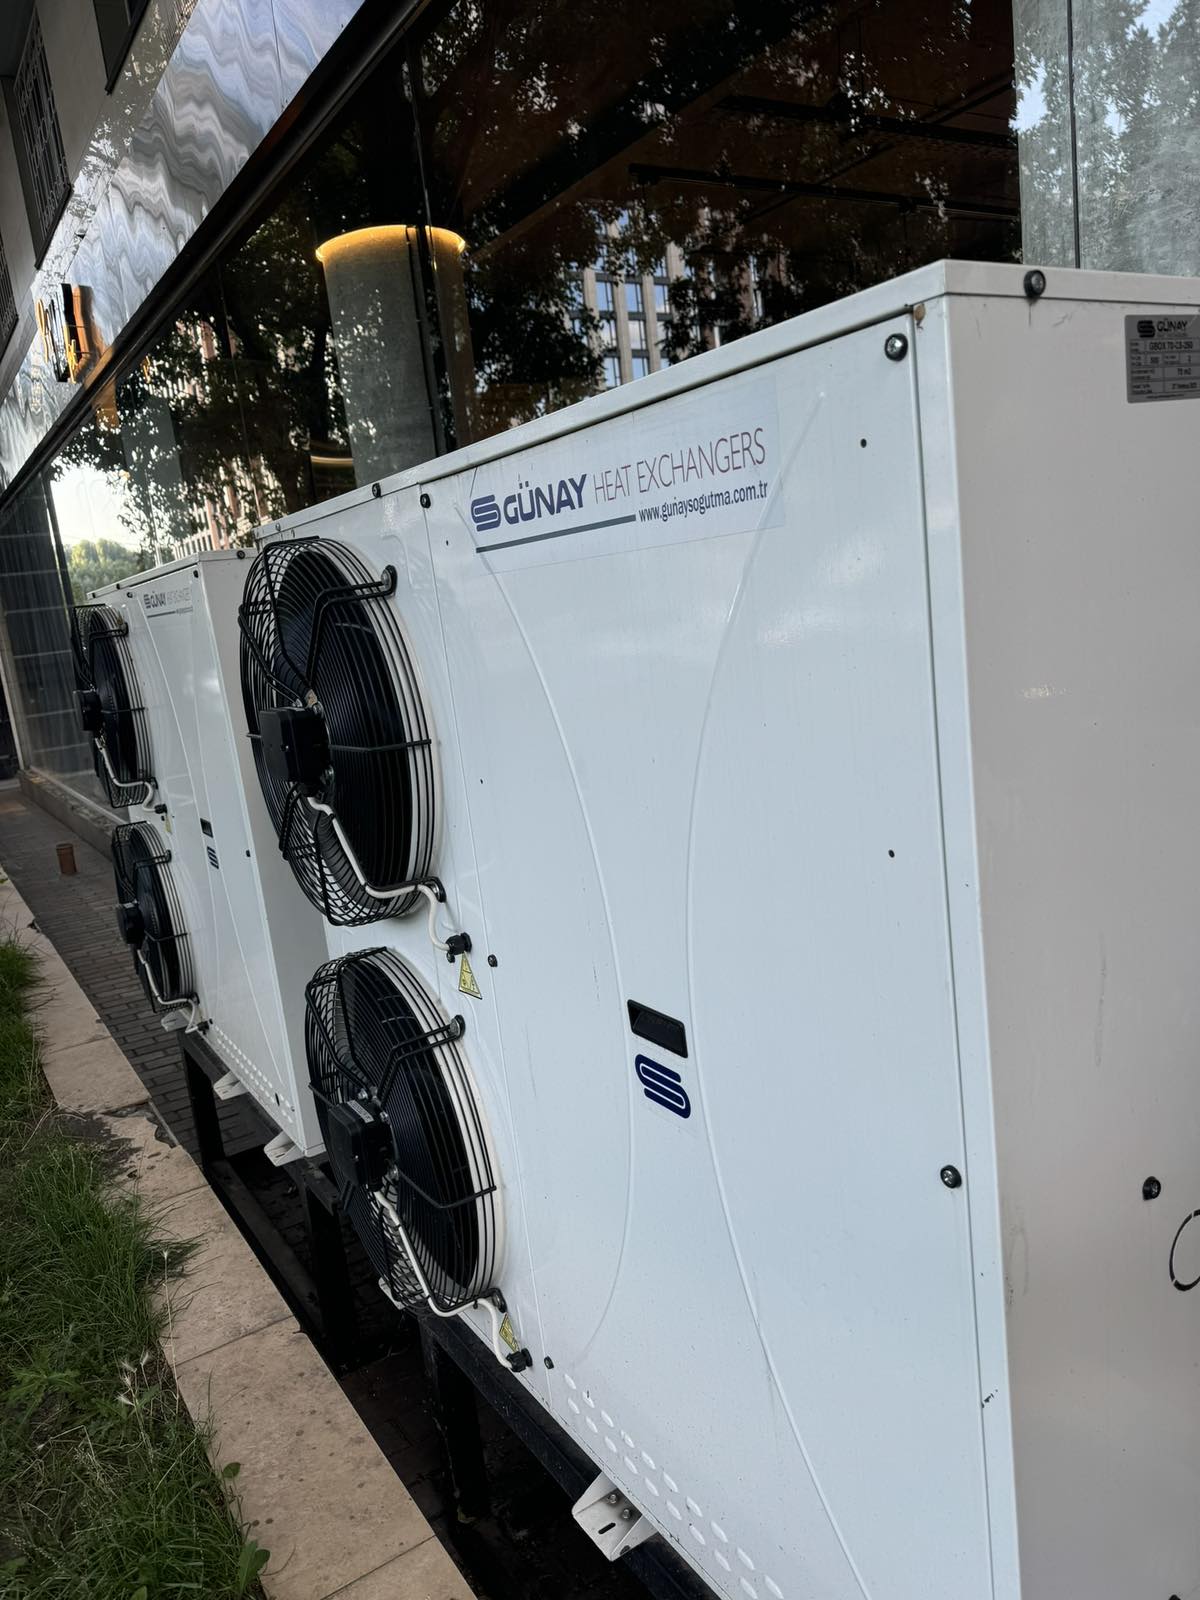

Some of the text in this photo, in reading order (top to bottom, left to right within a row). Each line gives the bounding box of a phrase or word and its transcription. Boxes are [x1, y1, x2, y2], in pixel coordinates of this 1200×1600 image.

[1157, 317, 1188, 331] GÜNAY
[503, 473, 588, 525] GÜNAY
[593, 464, 632, 504] HEAT
[636, 427, 766, 494] EXCHANGERS
[638, 480, 768, 522] www.gunaysogutma.com.tr
